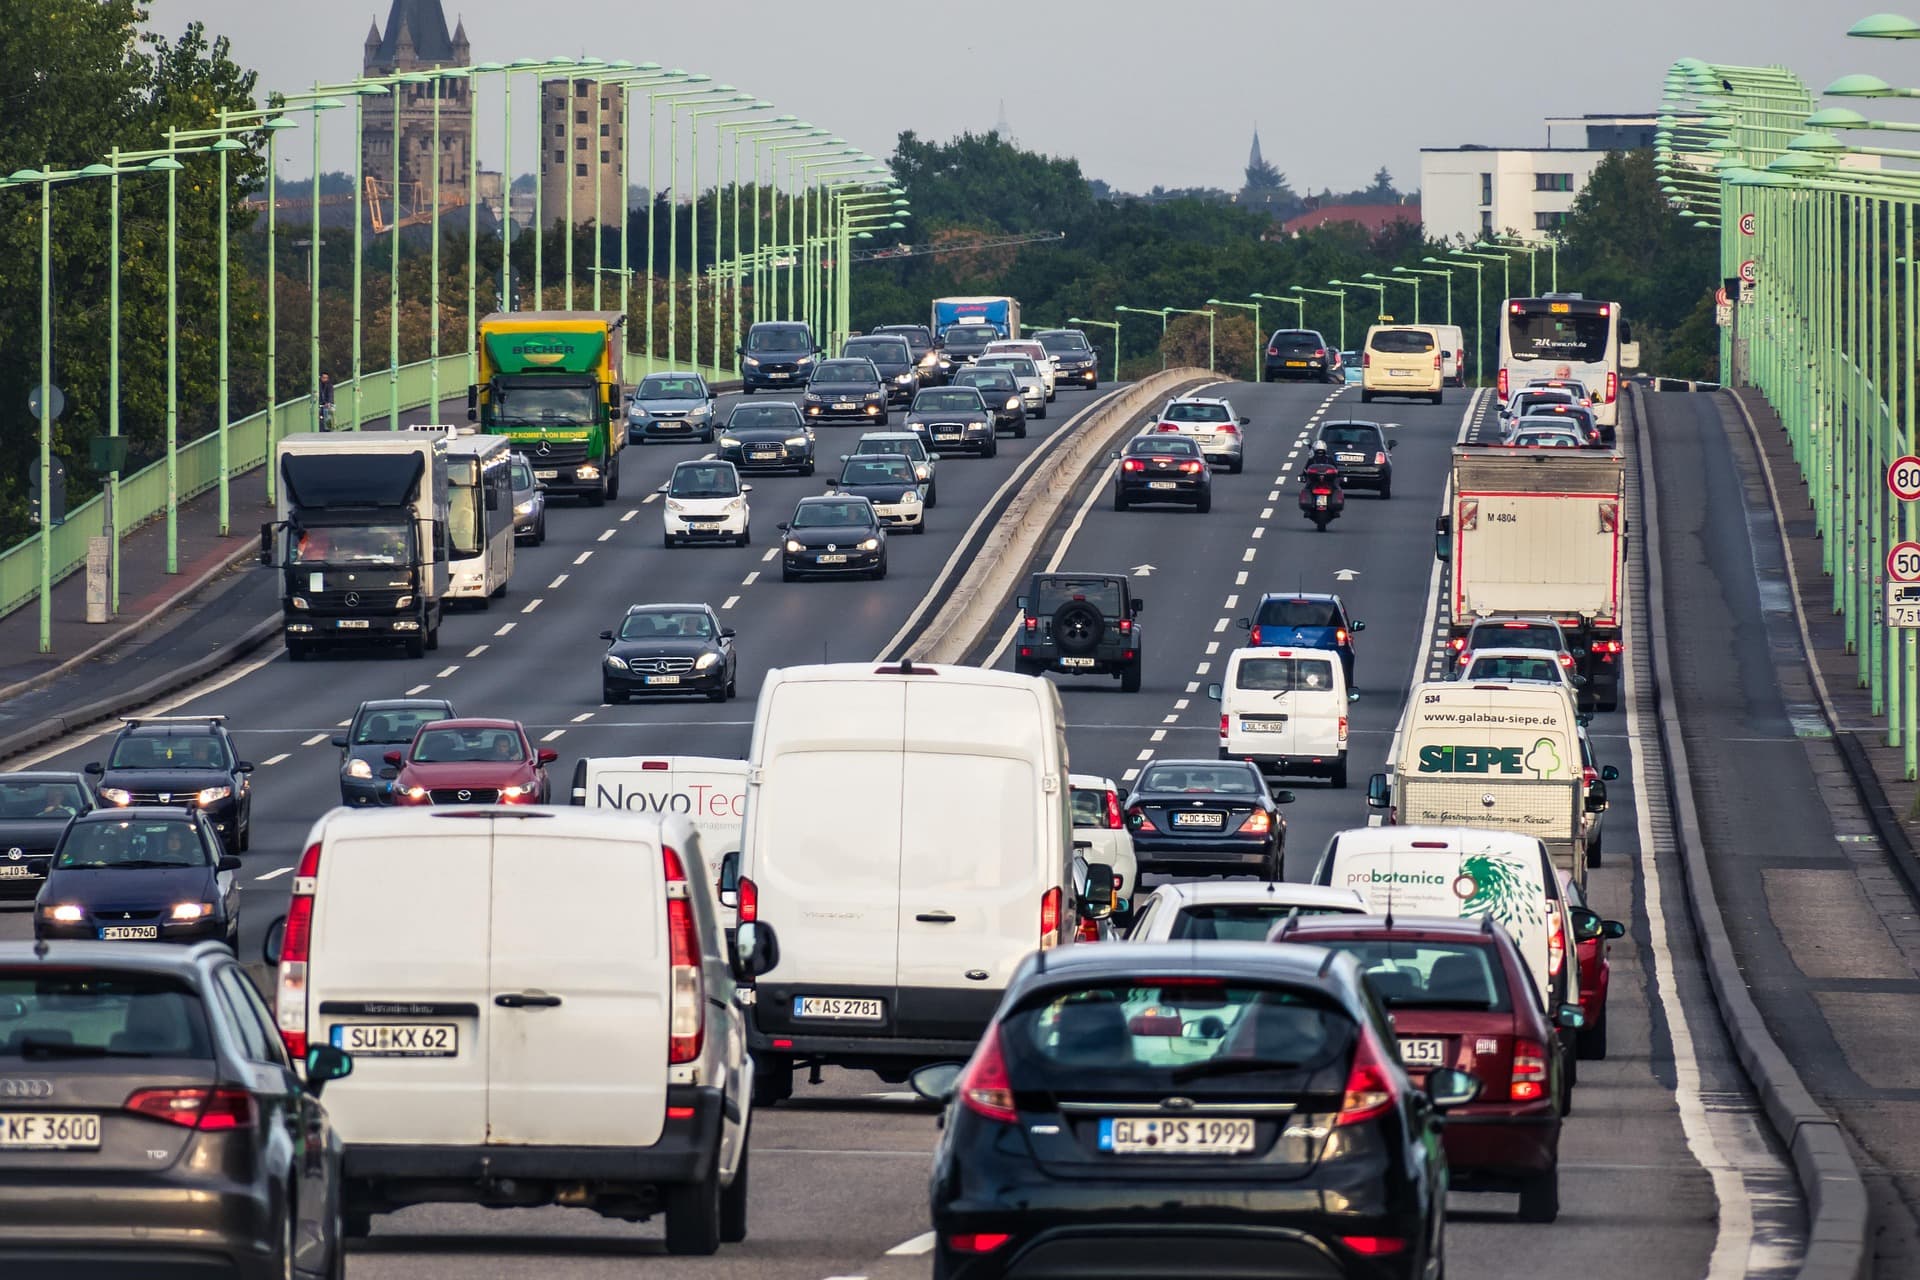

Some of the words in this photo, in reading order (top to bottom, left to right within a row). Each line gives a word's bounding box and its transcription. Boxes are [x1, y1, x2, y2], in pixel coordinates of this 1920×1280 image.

[512, 344, 574, 355] BECHER
[1897, 468, 1920, 488] 80
[1487, 512, 1494, 521] M
[1497, 513, 1516, 523] 4804
[1897, 554, 1920, 573] 50
[1896, 608, 1914, 623] 7,5
[1424, 695, 1441, 704] 534
[1424, 712, 1557, 727] www.galabau-siepe.de
[1201, 814, 1221, 823] 1350
[1347, 868, 1444, 886] probotanica
[131, 927, 156, 937] 7960
[803, 1000, 811, 1013] K
[821, 1000, 839, 1014] AS
[843, 1001, 877, 1015] 2781
[351, 1028, 377, 1048] SU
[391, 1028, 417, 1048] KX
[422, 1028, 447, 1048] 62
[1406, 1042, 1441, 1060] 151
[8, 1118, 36, 1141] KF
[43, 1118, 97, 1141] 3600
[1116, 1121, 1142, 1144] GL
[1162, 1121, 1189, 1144] PS
[1196, 1121, 1251, 1144] 1999
